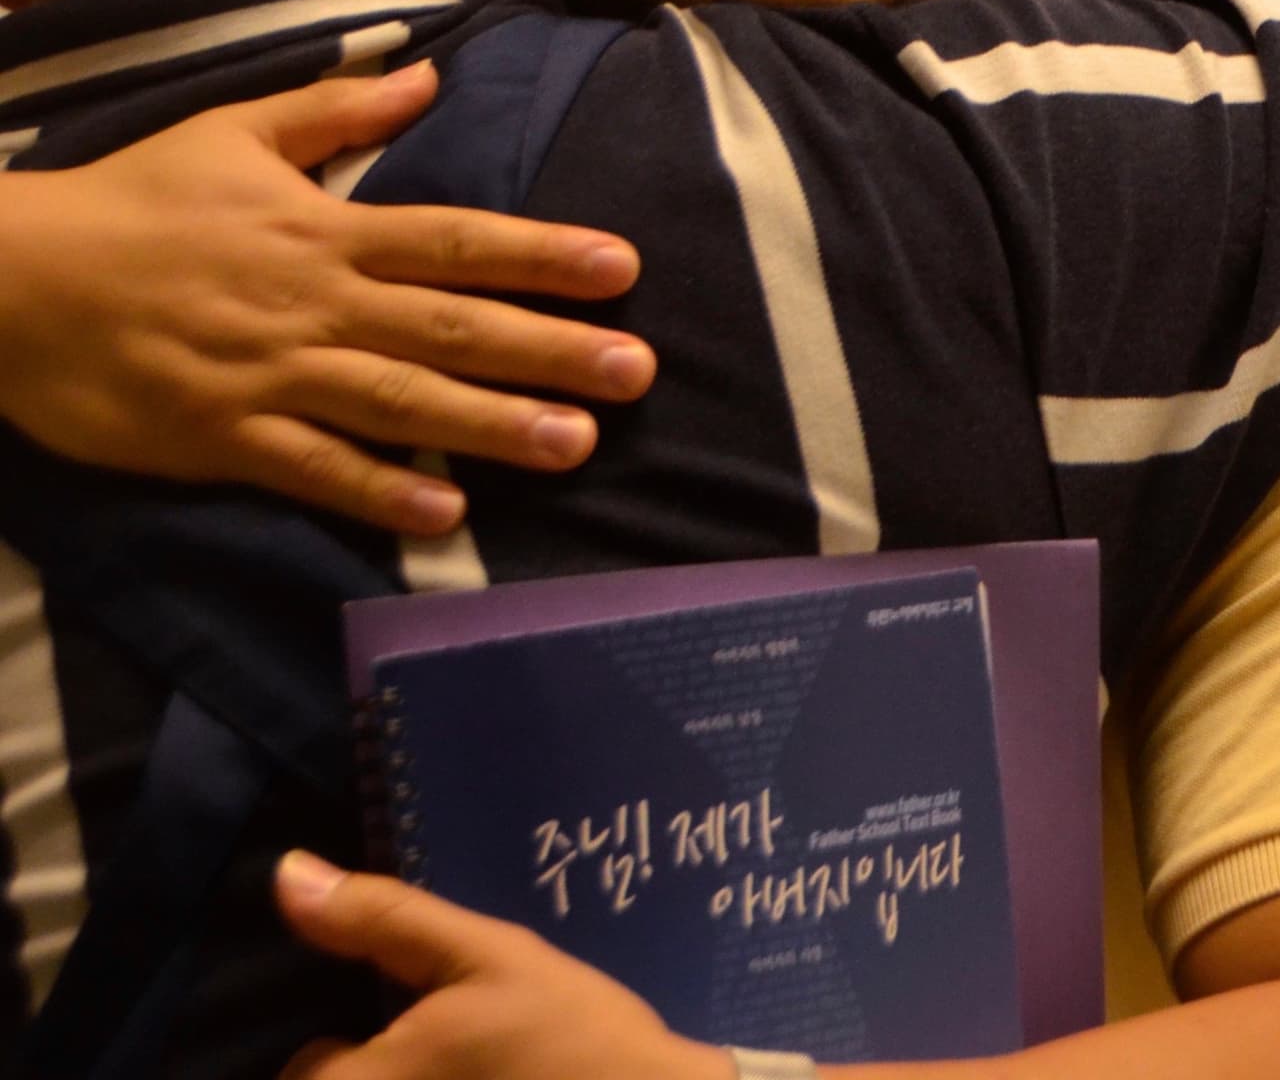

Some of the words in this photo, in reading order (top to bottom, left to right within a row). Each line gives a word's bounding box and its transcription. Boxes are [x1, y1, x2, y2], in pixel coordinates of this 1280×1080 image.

[534, 799, 654, 917] 주님!
[669, 789, 783, 864] 제가
[808, 827, 856, 851] Father
[857, 819, 900, 842] School
[931, 806, 962, 827] Book
[710, 832, 964, 943] 아버지입니다
